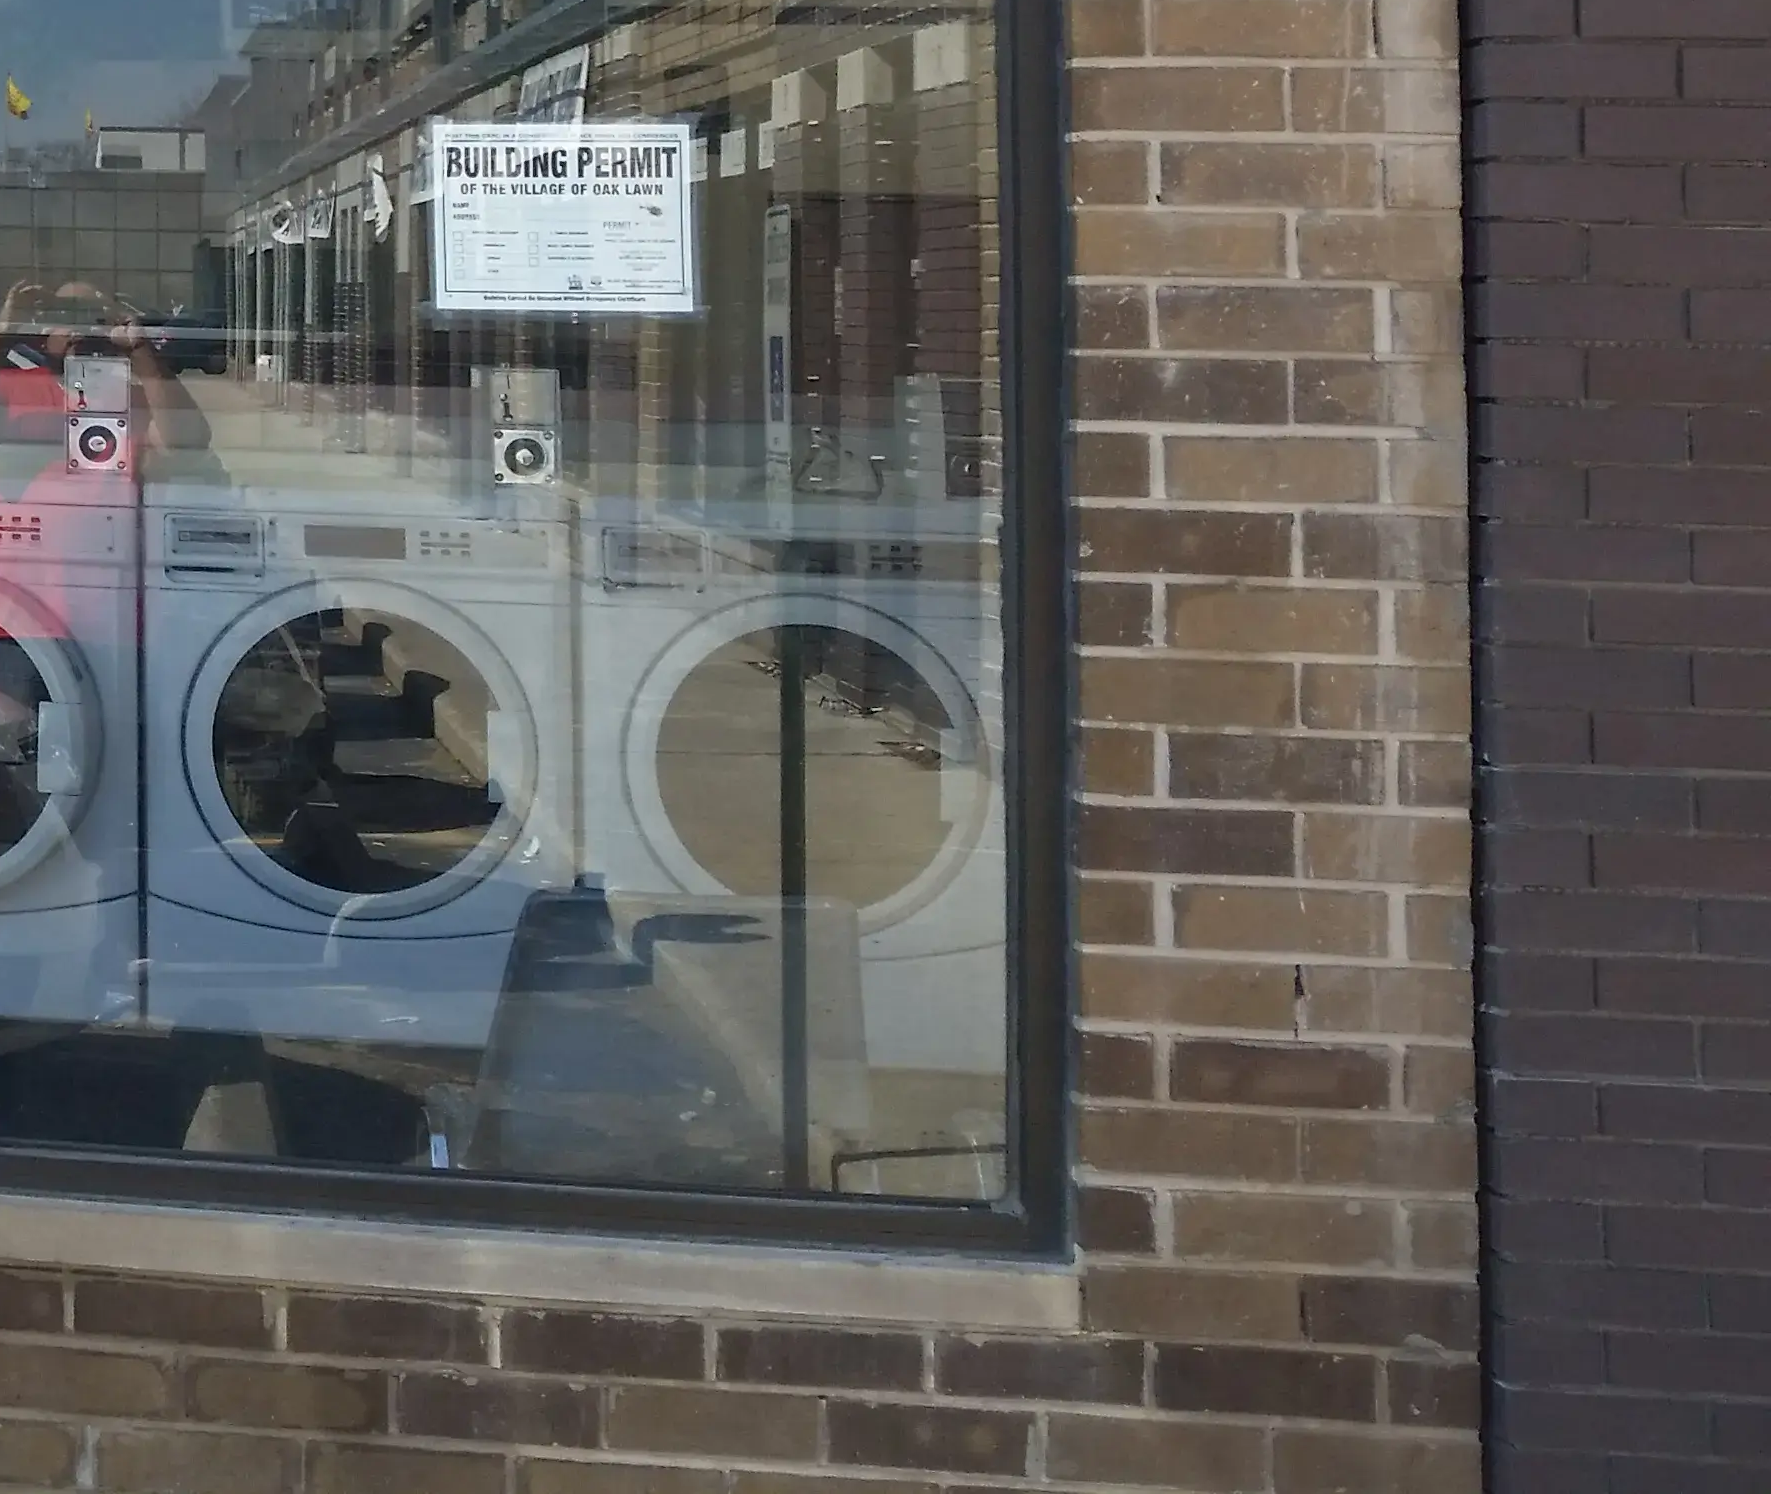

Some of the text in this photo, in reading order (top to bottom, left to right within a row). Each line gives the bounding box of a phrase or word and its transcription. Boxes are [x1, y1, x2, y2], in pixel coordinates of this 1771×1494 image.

[446, 146, 677, 179] BUILDING PERMIT
[460, 183, 664, 196] OF THE VILLAGE OF OAK LAWN
